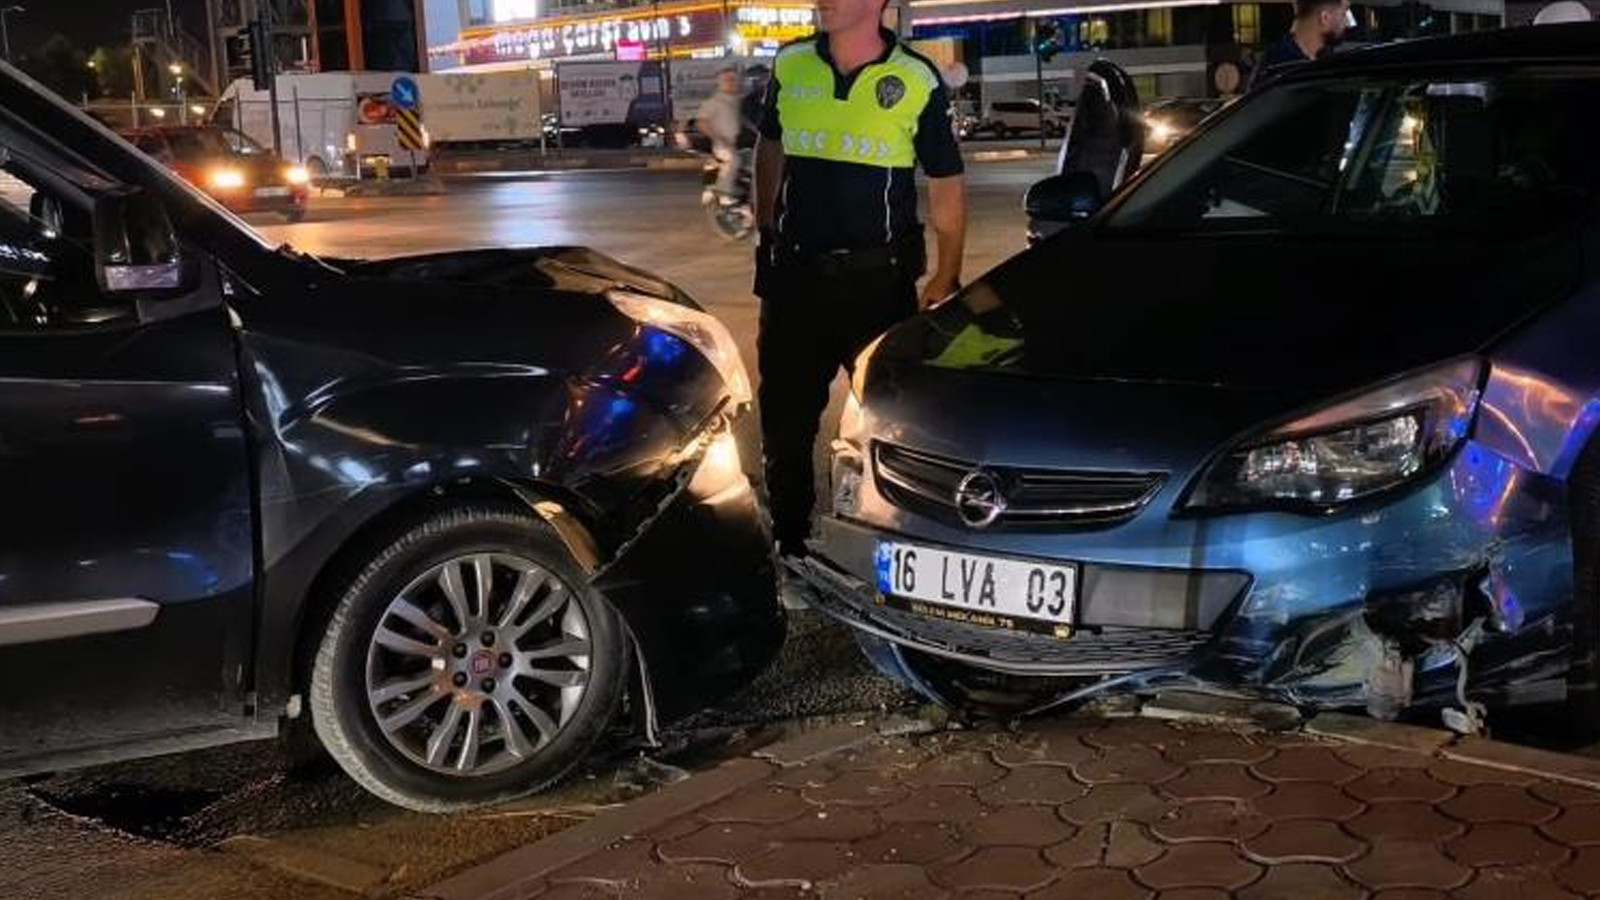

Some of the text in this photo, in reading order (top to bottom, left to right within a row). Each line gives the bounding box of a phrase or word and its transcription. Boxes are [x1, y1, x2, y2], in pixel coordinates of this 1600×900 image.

[894, 548, 1067, 616] 16 LVA 03
